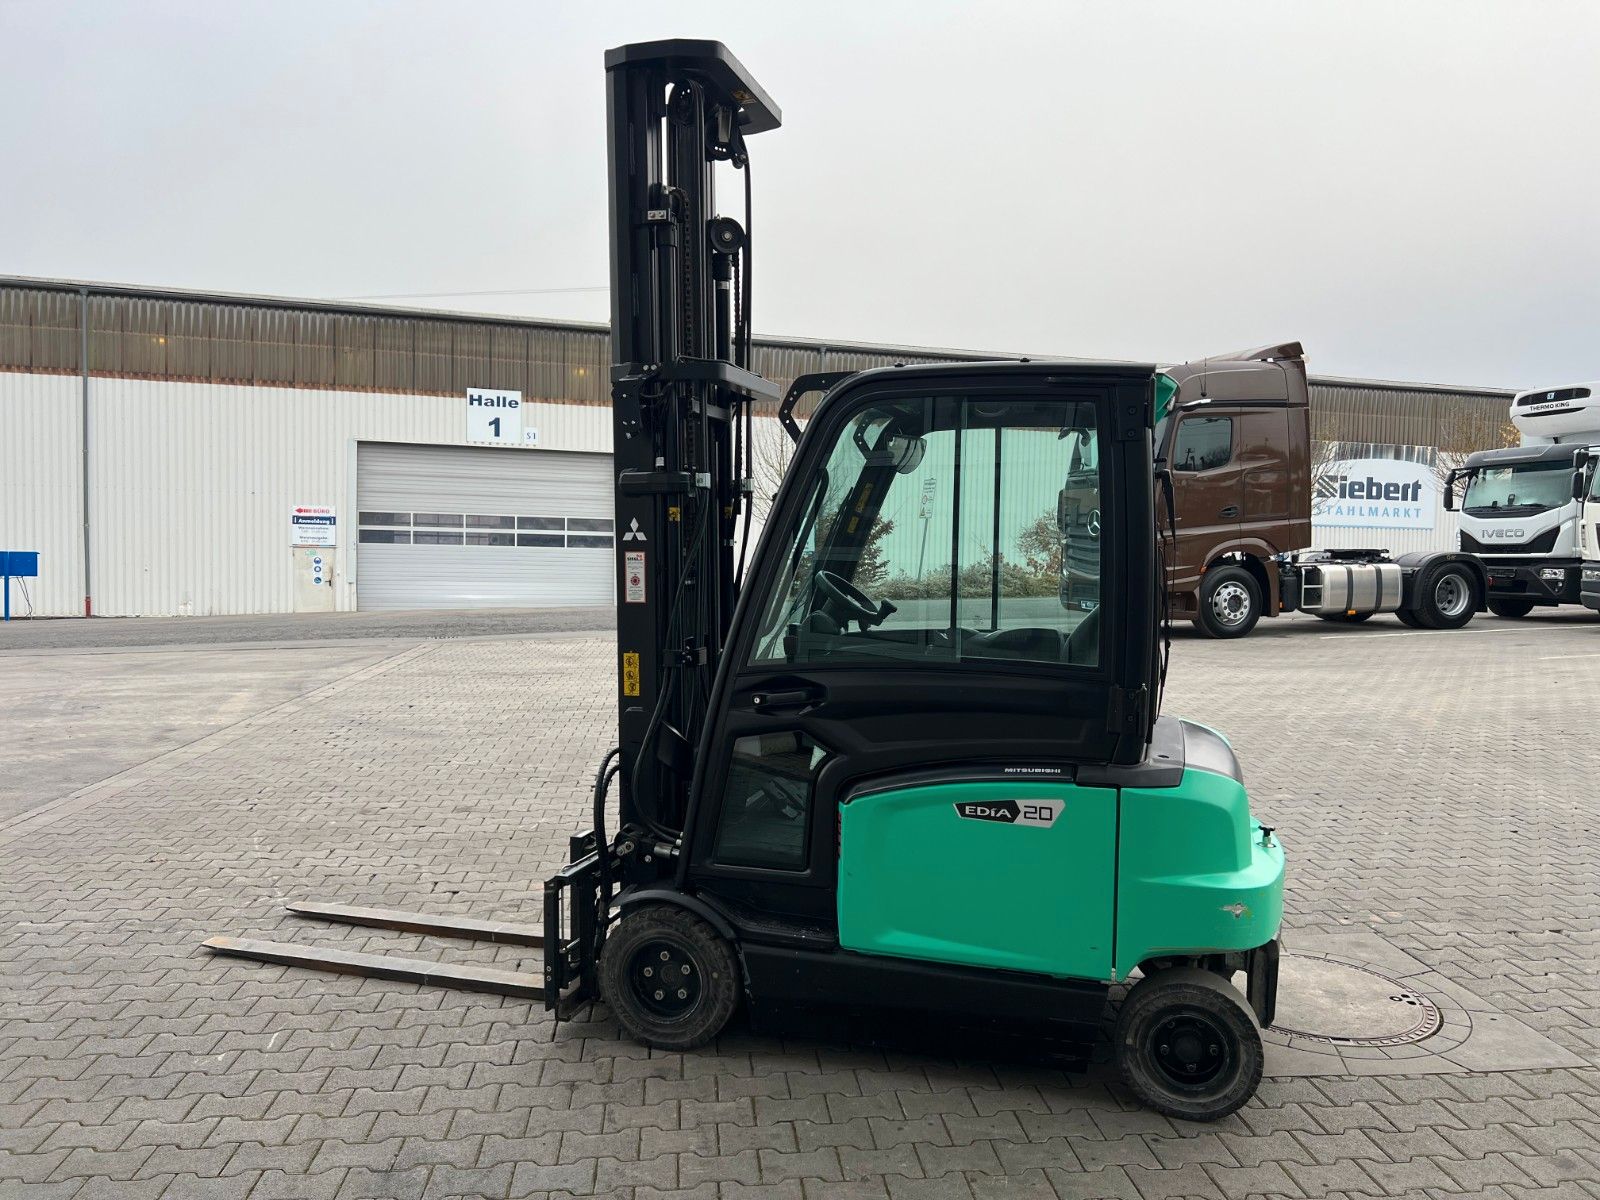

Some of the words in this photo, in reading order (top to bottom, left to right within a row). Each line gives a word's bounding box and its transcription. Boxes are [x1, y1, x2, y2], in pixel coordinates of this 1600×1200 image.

[469, 394, 519, 409] Halle
[1530, 403, 1554, 412] THERMO
[1555, 401, 1570, 409] KING
[488, 417, 501, 437] 1
[1315, 505, 1422, 519] STAHLMARKT
[298, 518, 330, 526] Anmeldung
[1481, 528, 1525, 539] IVECO
[1023, 805, 1053, 821] 20
